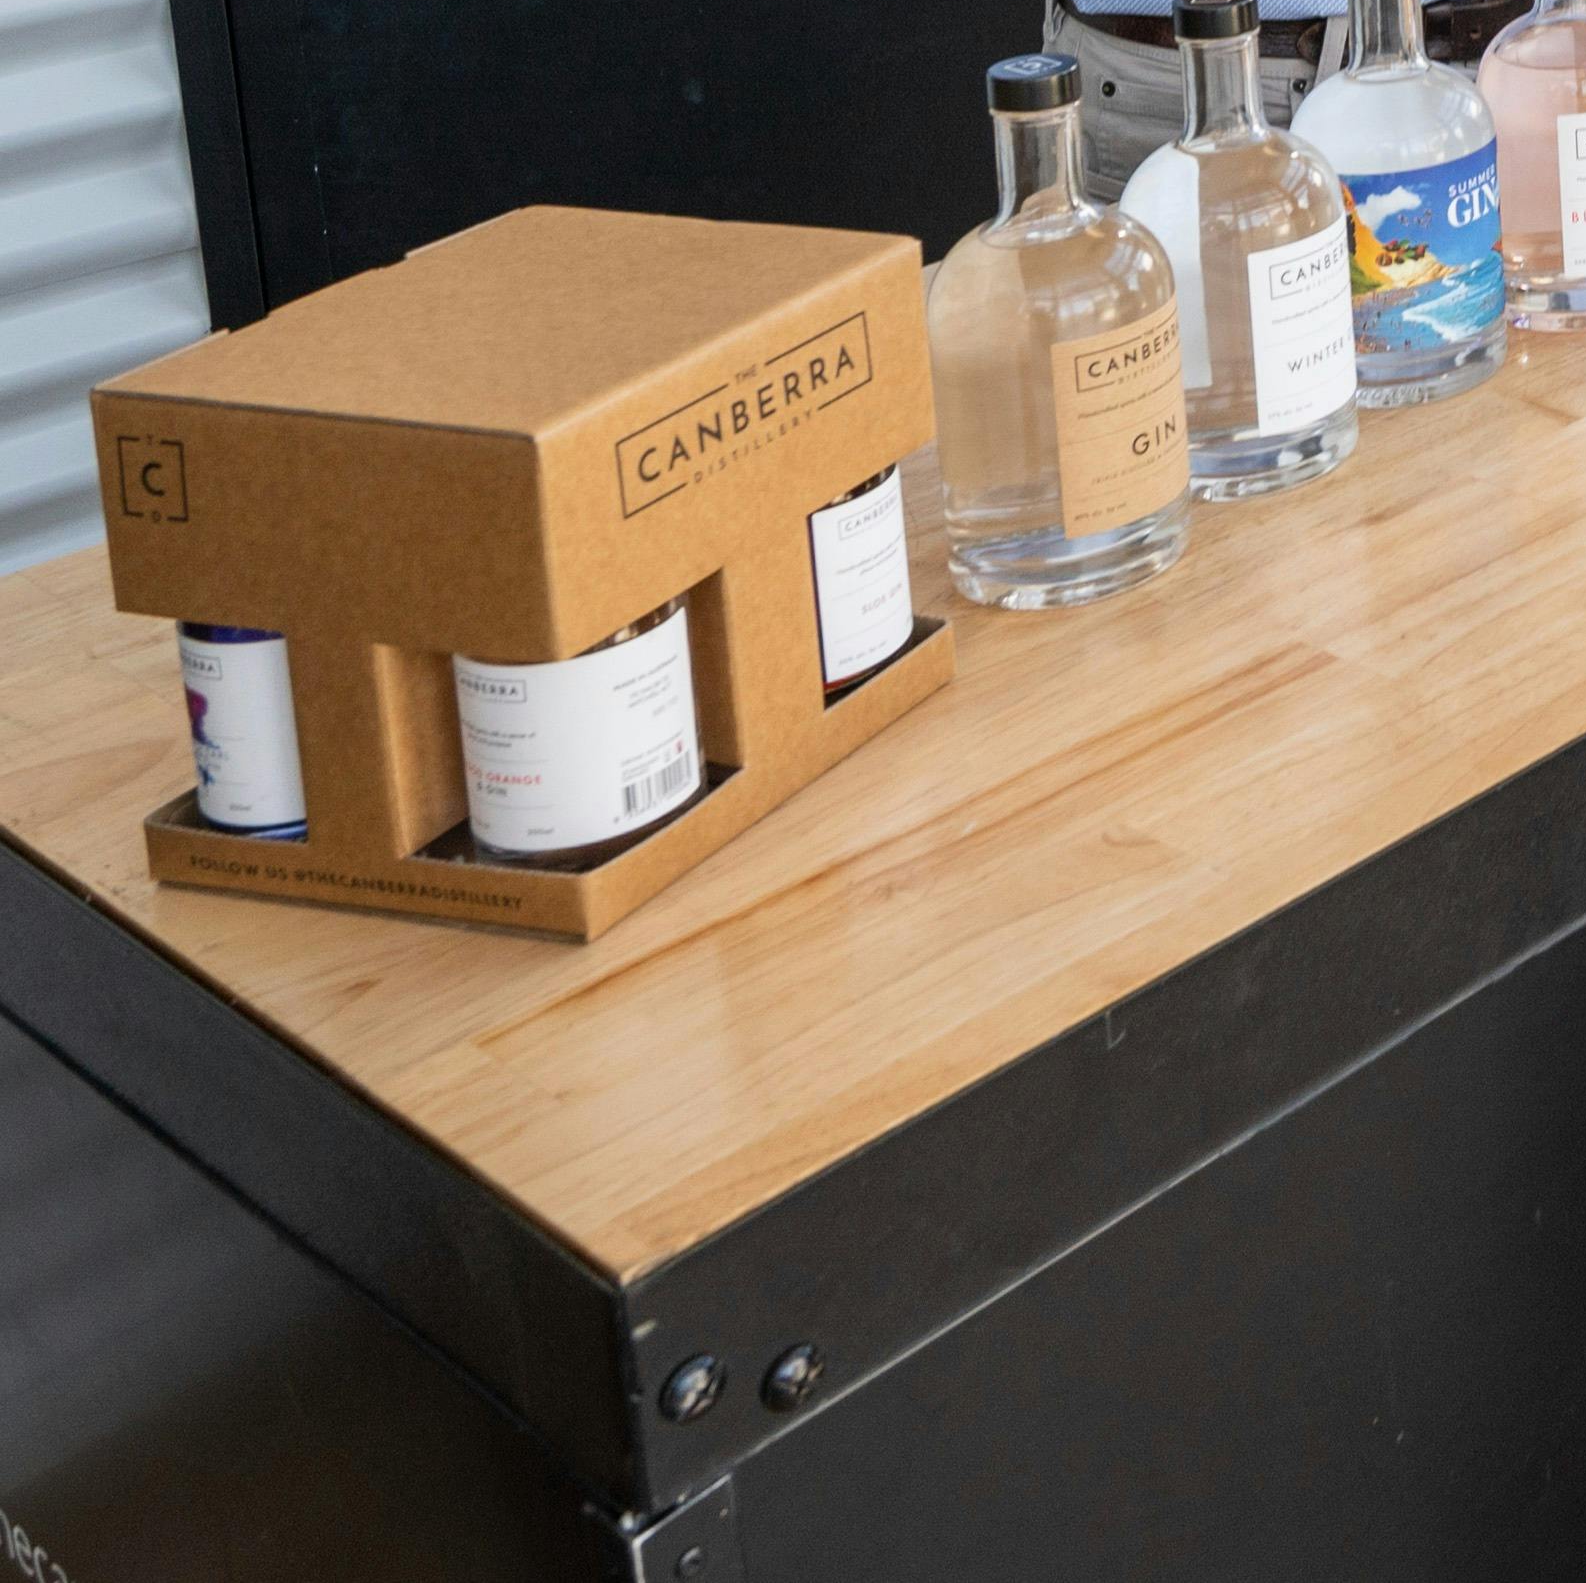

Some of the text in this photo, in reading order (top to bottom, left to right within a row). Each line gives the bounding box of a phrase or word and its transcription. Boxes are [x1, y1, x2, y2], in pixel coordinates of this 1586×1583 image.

[1447, 176, 1496, 229] GIN
[734, 364, 758, 385] THE
[637, 344, 855, 483] CANBERRA
[693, 407, 813, 484] DISTILLERY
[1132, 415, 1177, 456] GIN
[141, 462, 164, 497] C
[190, 853, 259, 878] FOLLOW
